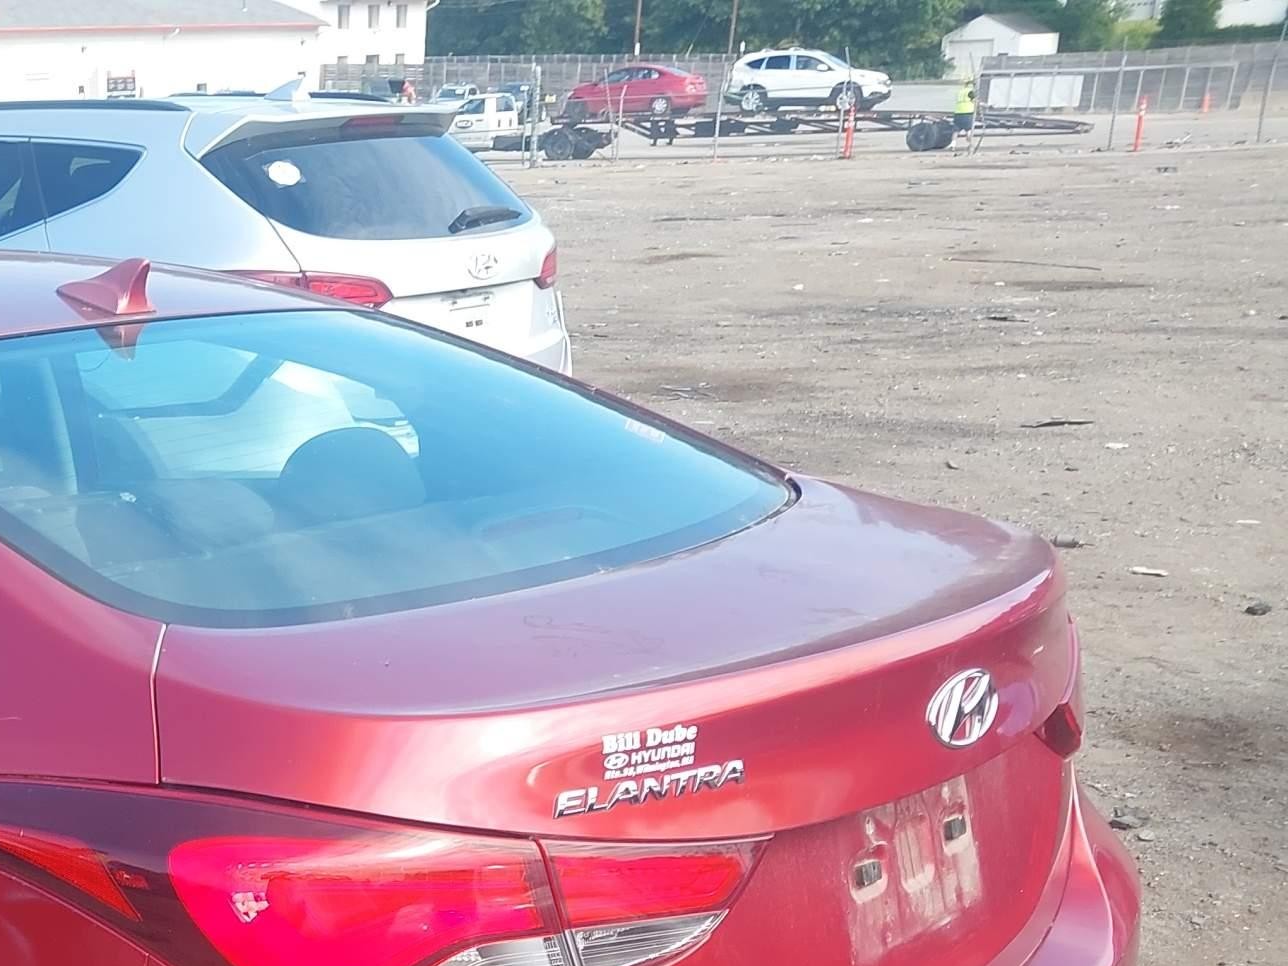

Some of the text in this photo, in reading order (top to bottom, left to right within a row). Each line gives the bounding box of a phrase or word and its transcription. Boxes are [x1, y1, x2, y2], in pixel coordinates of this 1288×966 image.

[602, 725, 698, 754] Bill Dube
[631, 742, 696, 764] HYUNDAI
[553, 760, 744, 819] ELANTRA
